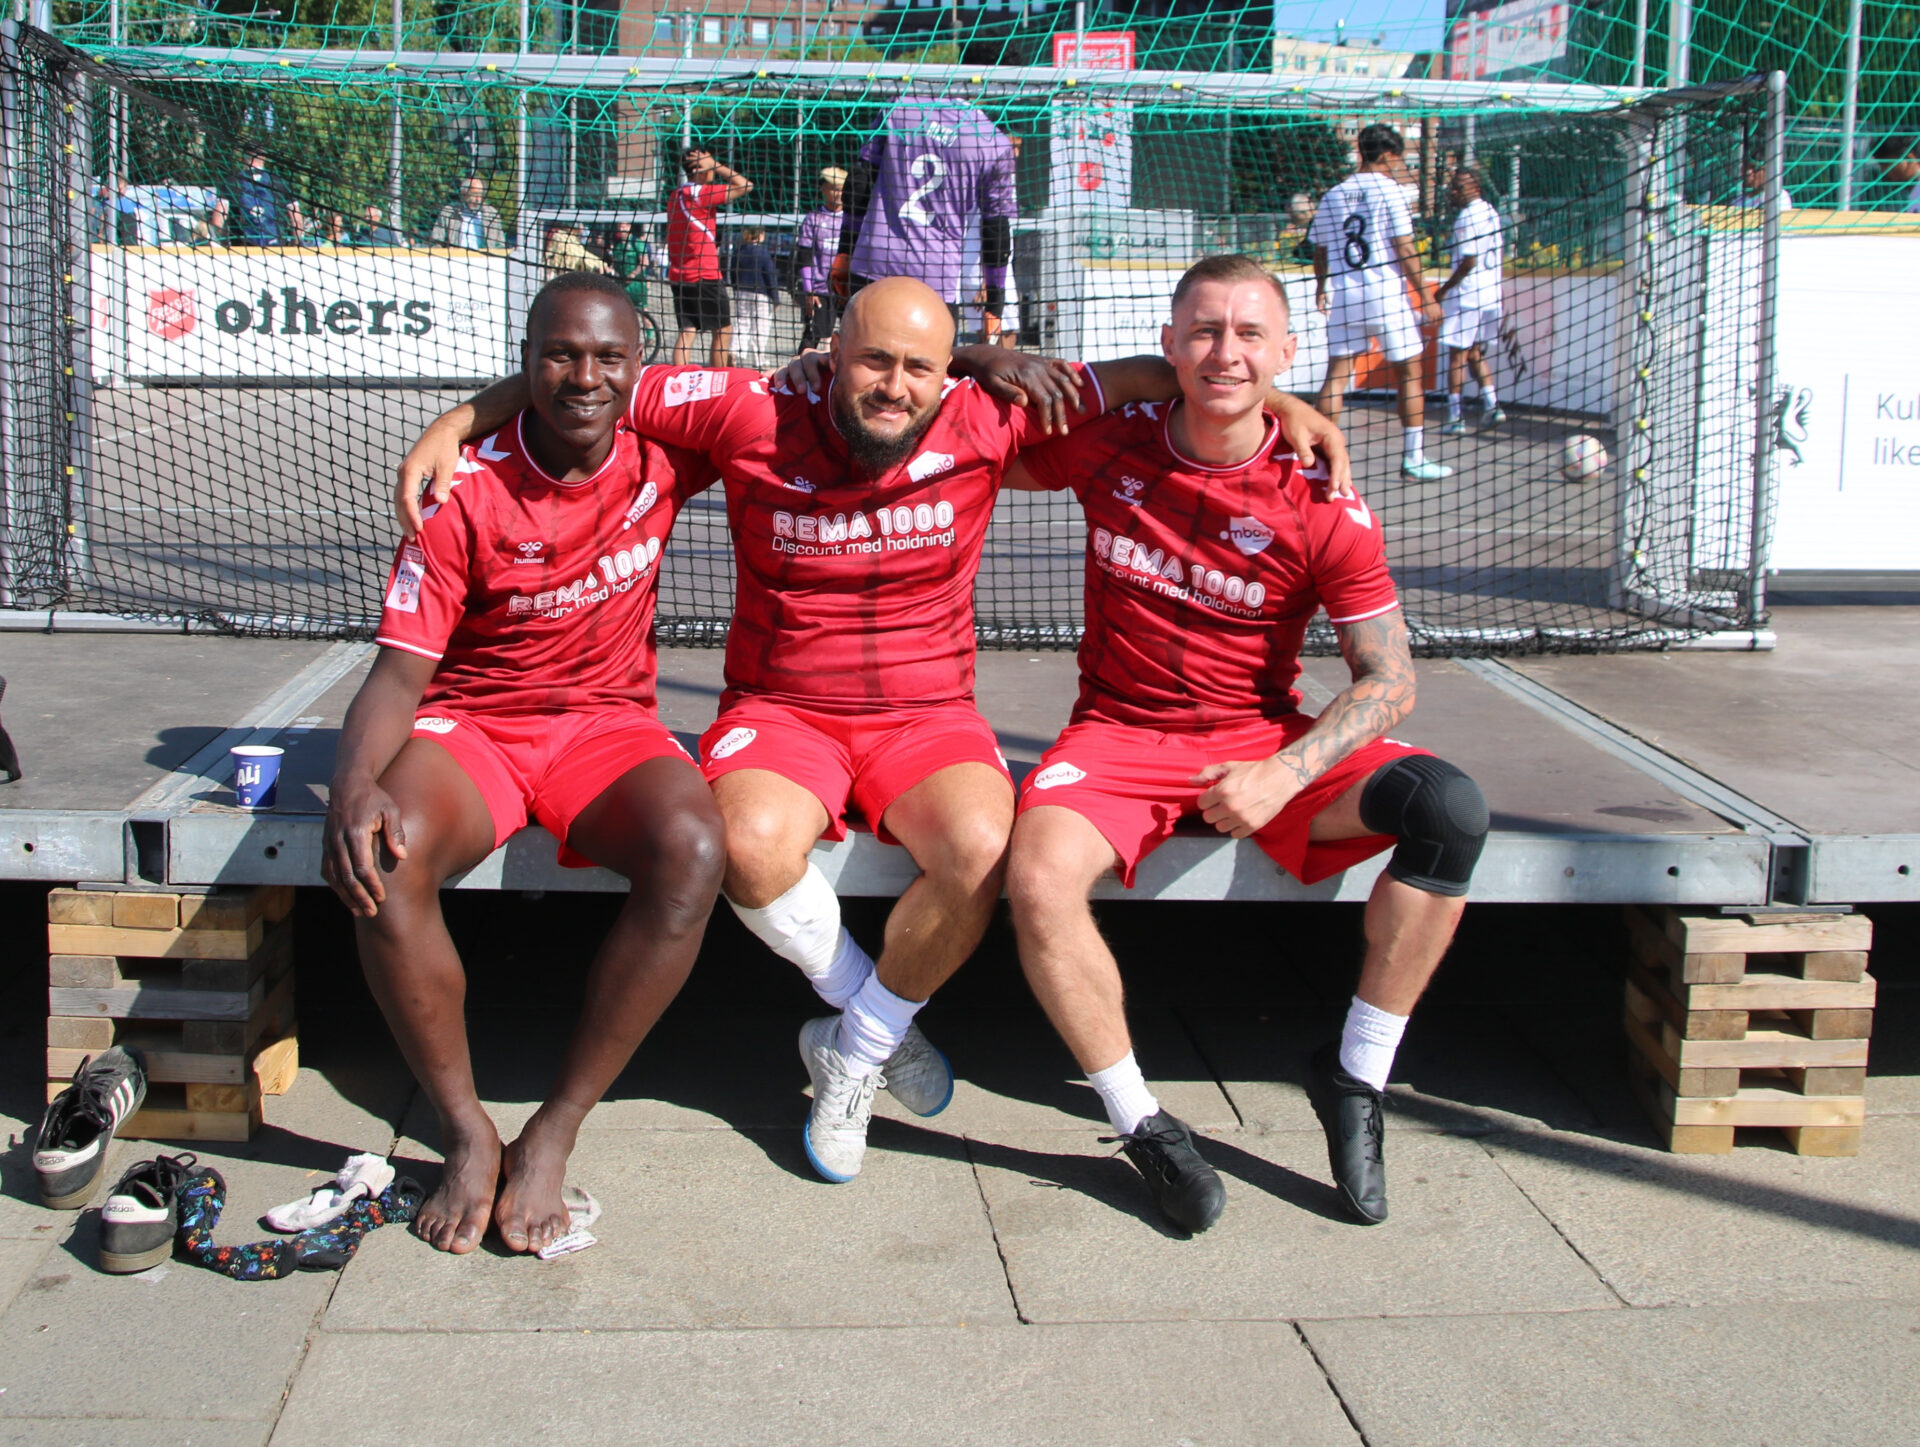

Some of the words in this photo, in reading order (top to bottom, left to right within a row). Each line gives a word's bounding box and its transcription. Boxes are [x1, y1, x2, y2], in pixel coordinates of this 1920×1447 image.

[898, 153, 946, 225] 2
[1344, 214, 1370, 268] 8
[214, 287, 433, 336] others
[772, 536, 842, 556] Discount
[846, 537, 882, 555] med
[886, 527, 955, 551] holdning!
[773, 511, 872, 544] REMA
[876, 500, 954, 536] 1000
[509, 572, 598, 612] REMA
[598, 537, 661, 583] 1000
[1093, 527, 1184, 583] REMA
[1190, 564, 1266, 608] 1000
[1153, 580, 1189, 601] med
